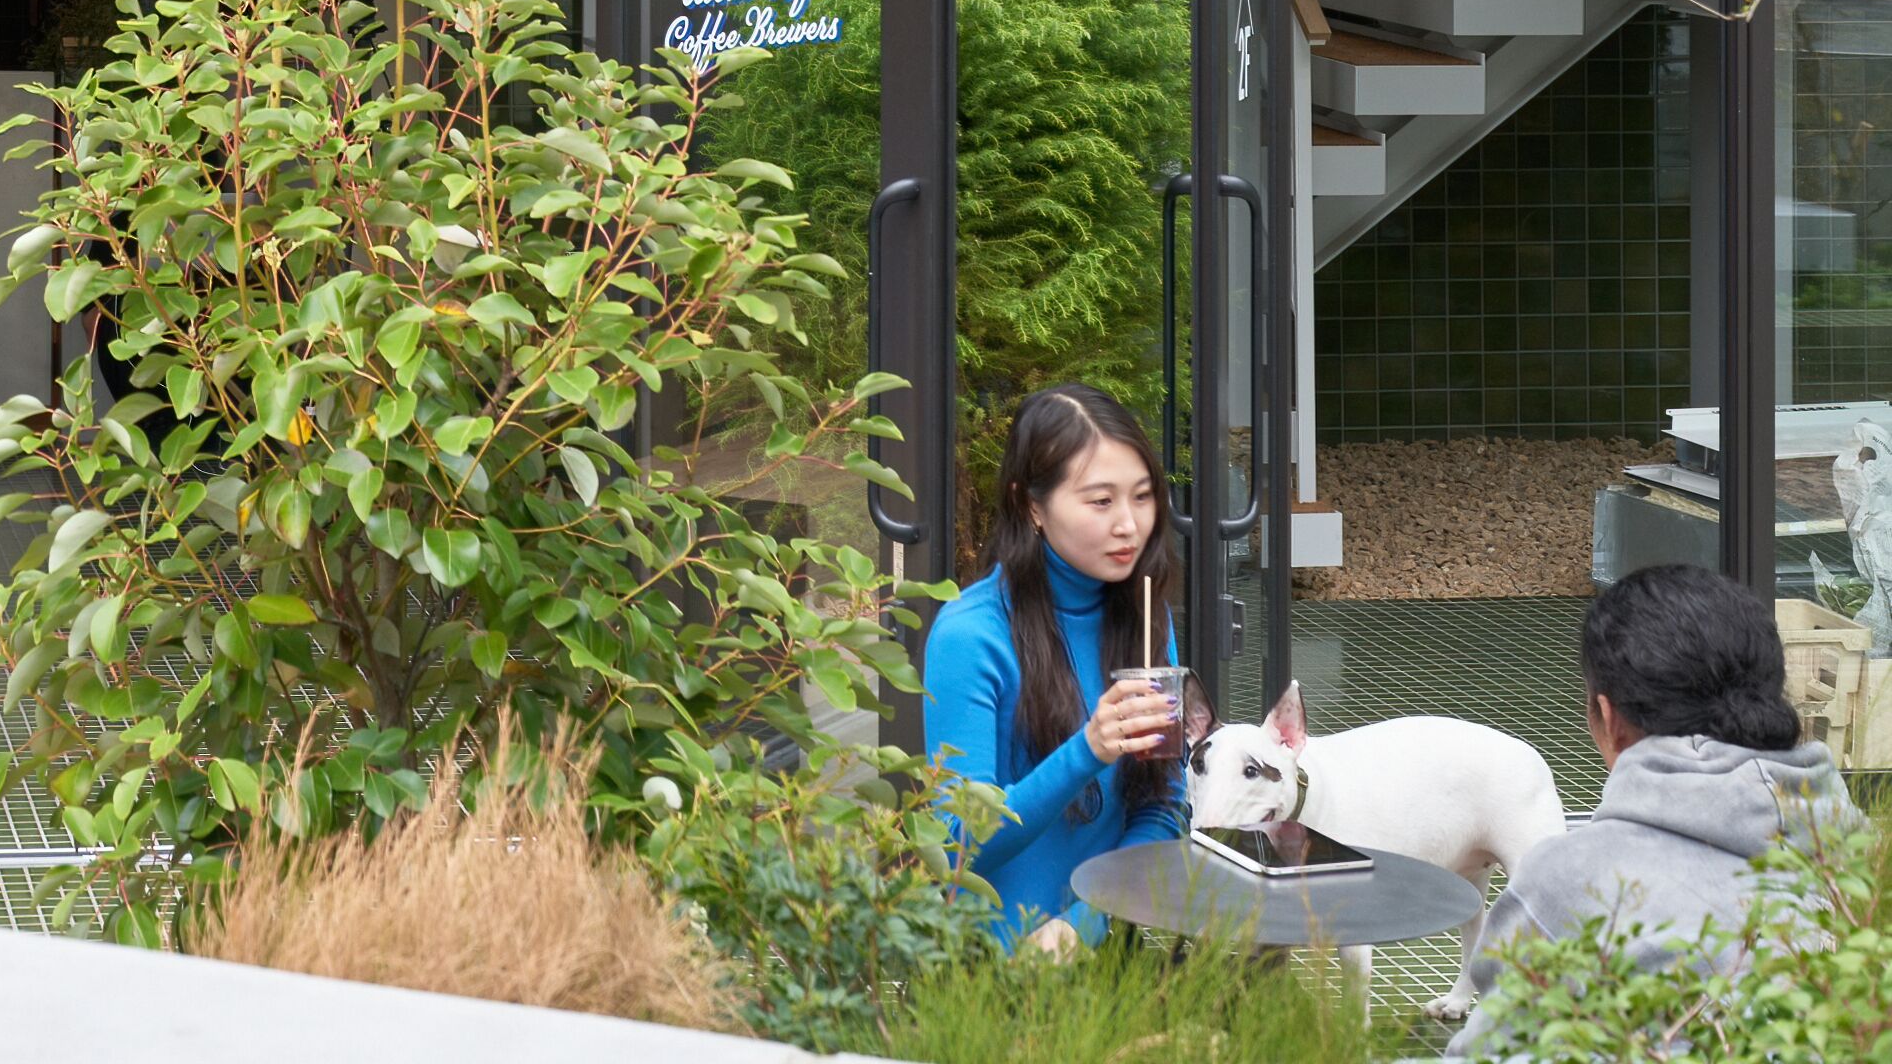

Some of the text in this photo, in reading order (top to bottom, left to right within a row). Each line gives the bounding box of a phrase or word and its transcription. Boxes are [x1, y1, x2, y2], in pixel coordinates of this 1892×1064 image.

[664, 5, 843, 74] Coffee Brewers
[1238, 25, 1252, 101] 2F
